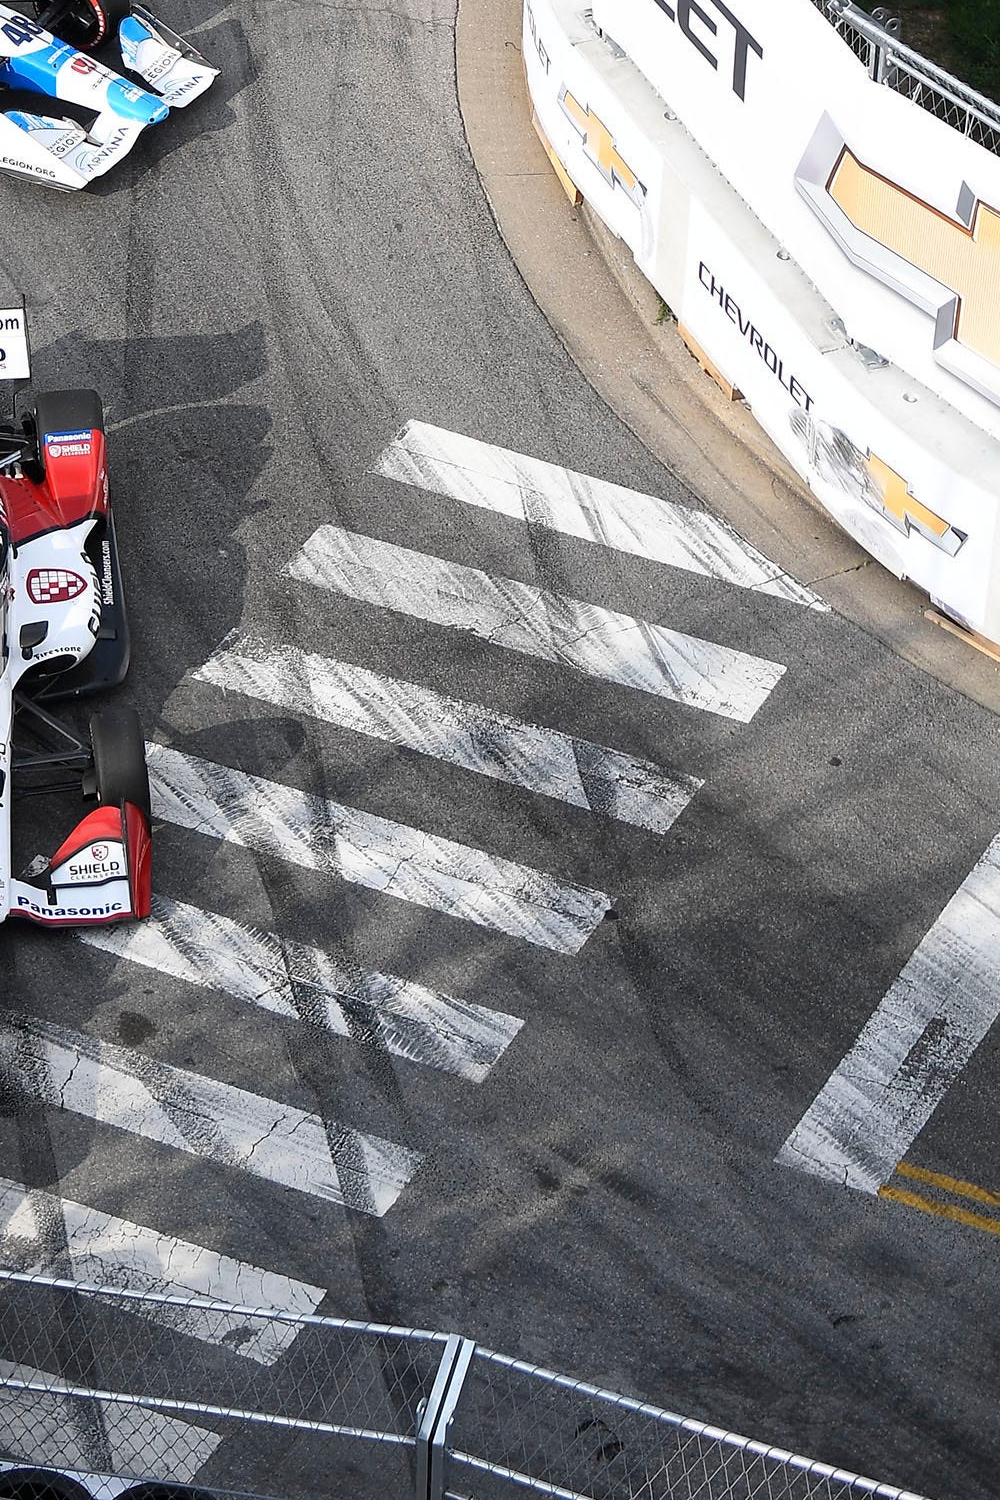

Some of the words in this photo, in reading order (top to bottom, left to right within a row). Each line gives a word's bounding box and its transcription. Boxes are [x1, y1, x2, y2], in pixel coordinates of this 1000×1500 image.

[1, 15, 44, 47] 48
[698, 260, 815, 412] CHEVROLET
[46, 432, 92, 443] Panasonic
[61, 443, 91, 455] SHIELD
[102, 540, 113, 606] ShieldCleansers.com
[33, 645, 82, 661] Firestone
[69, 861, 120, 876] SHIELD
[17, 895, 122, 916] Panasonic
